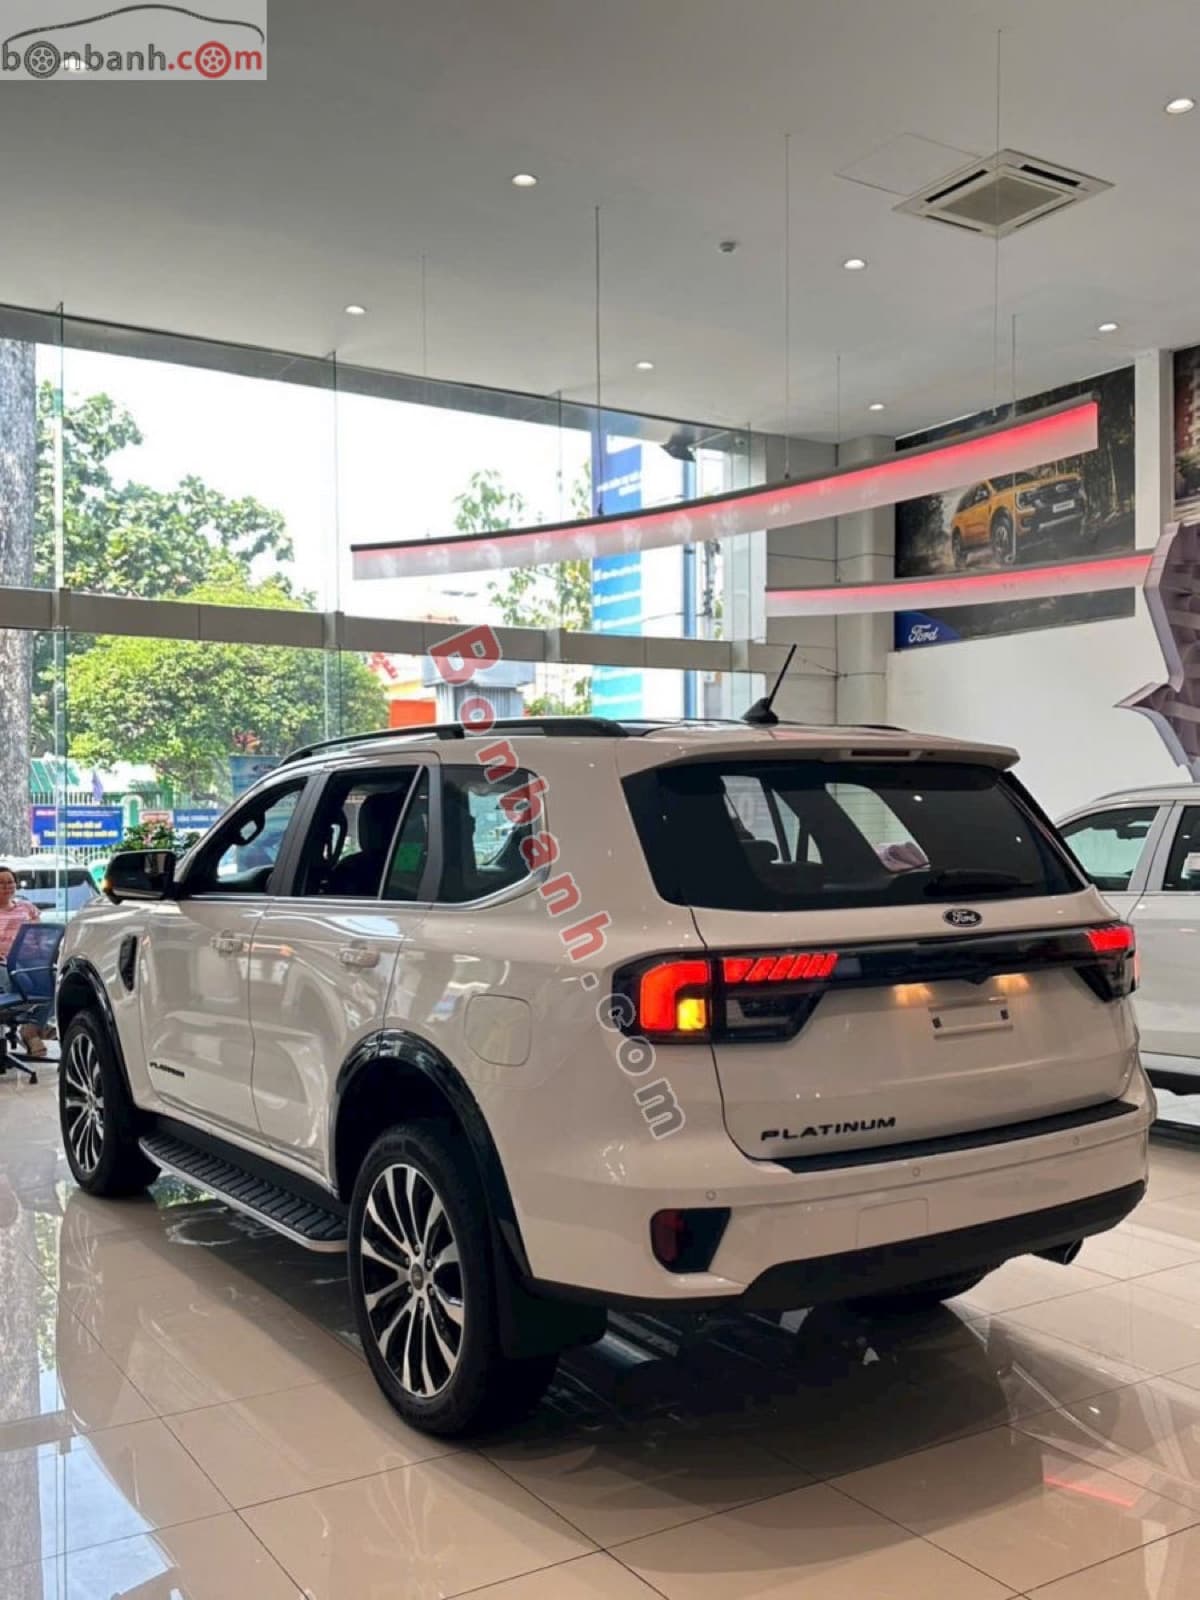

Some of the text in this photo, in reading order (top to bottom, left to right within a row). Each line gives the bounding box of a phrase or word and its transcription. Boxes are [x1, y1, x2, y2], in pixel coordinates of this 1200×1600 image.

[908, 624, 939, 643] Ford
[952, 911, 977, 923] Ford
[761, 1116, 896, 1141] PLATINUM
